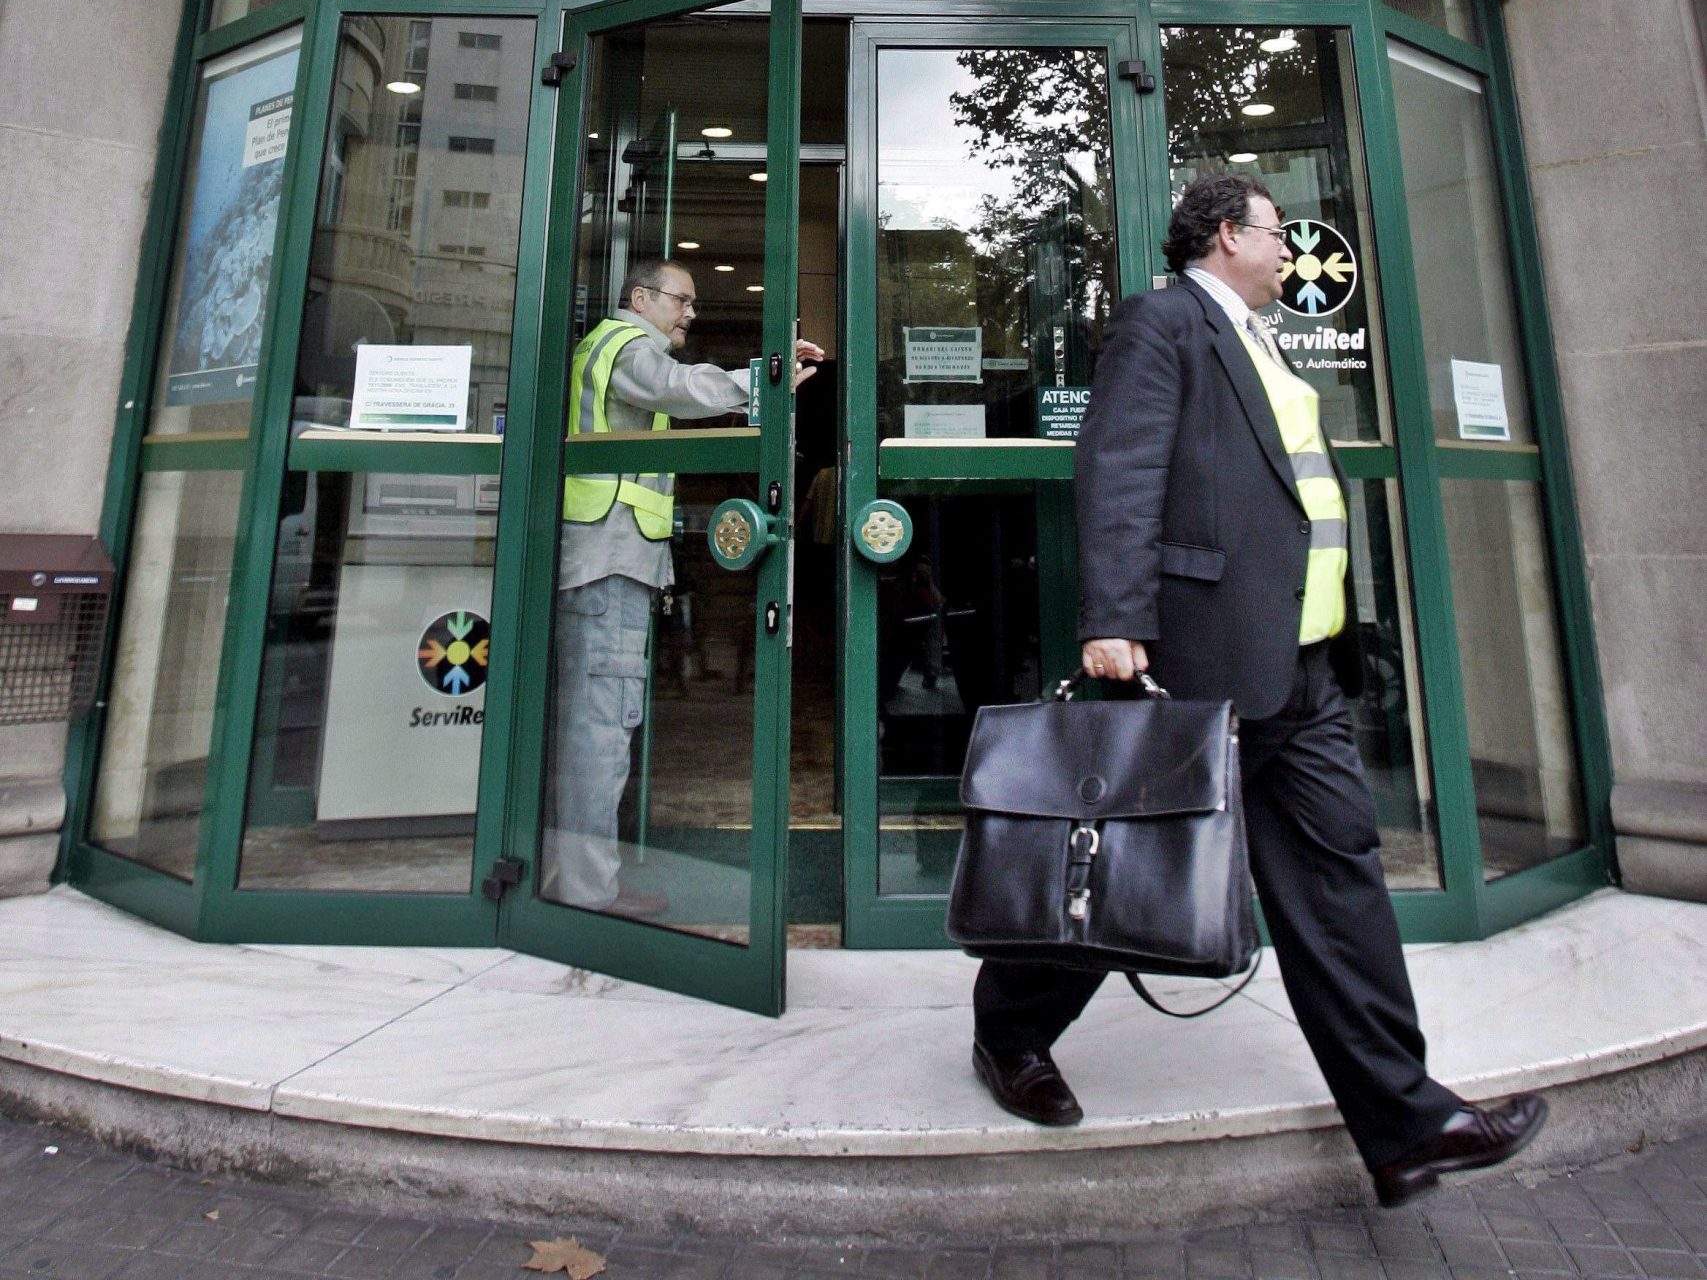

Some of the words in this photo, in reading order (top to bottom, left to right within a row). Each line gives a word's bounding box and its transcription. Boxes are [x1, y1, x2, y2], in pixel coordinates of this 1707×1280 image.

[1267, 326, 1366, 350] erviRed
[1306, 357, 1367, 369] Automático
[1042, 390, 1091, 404] ATENC
